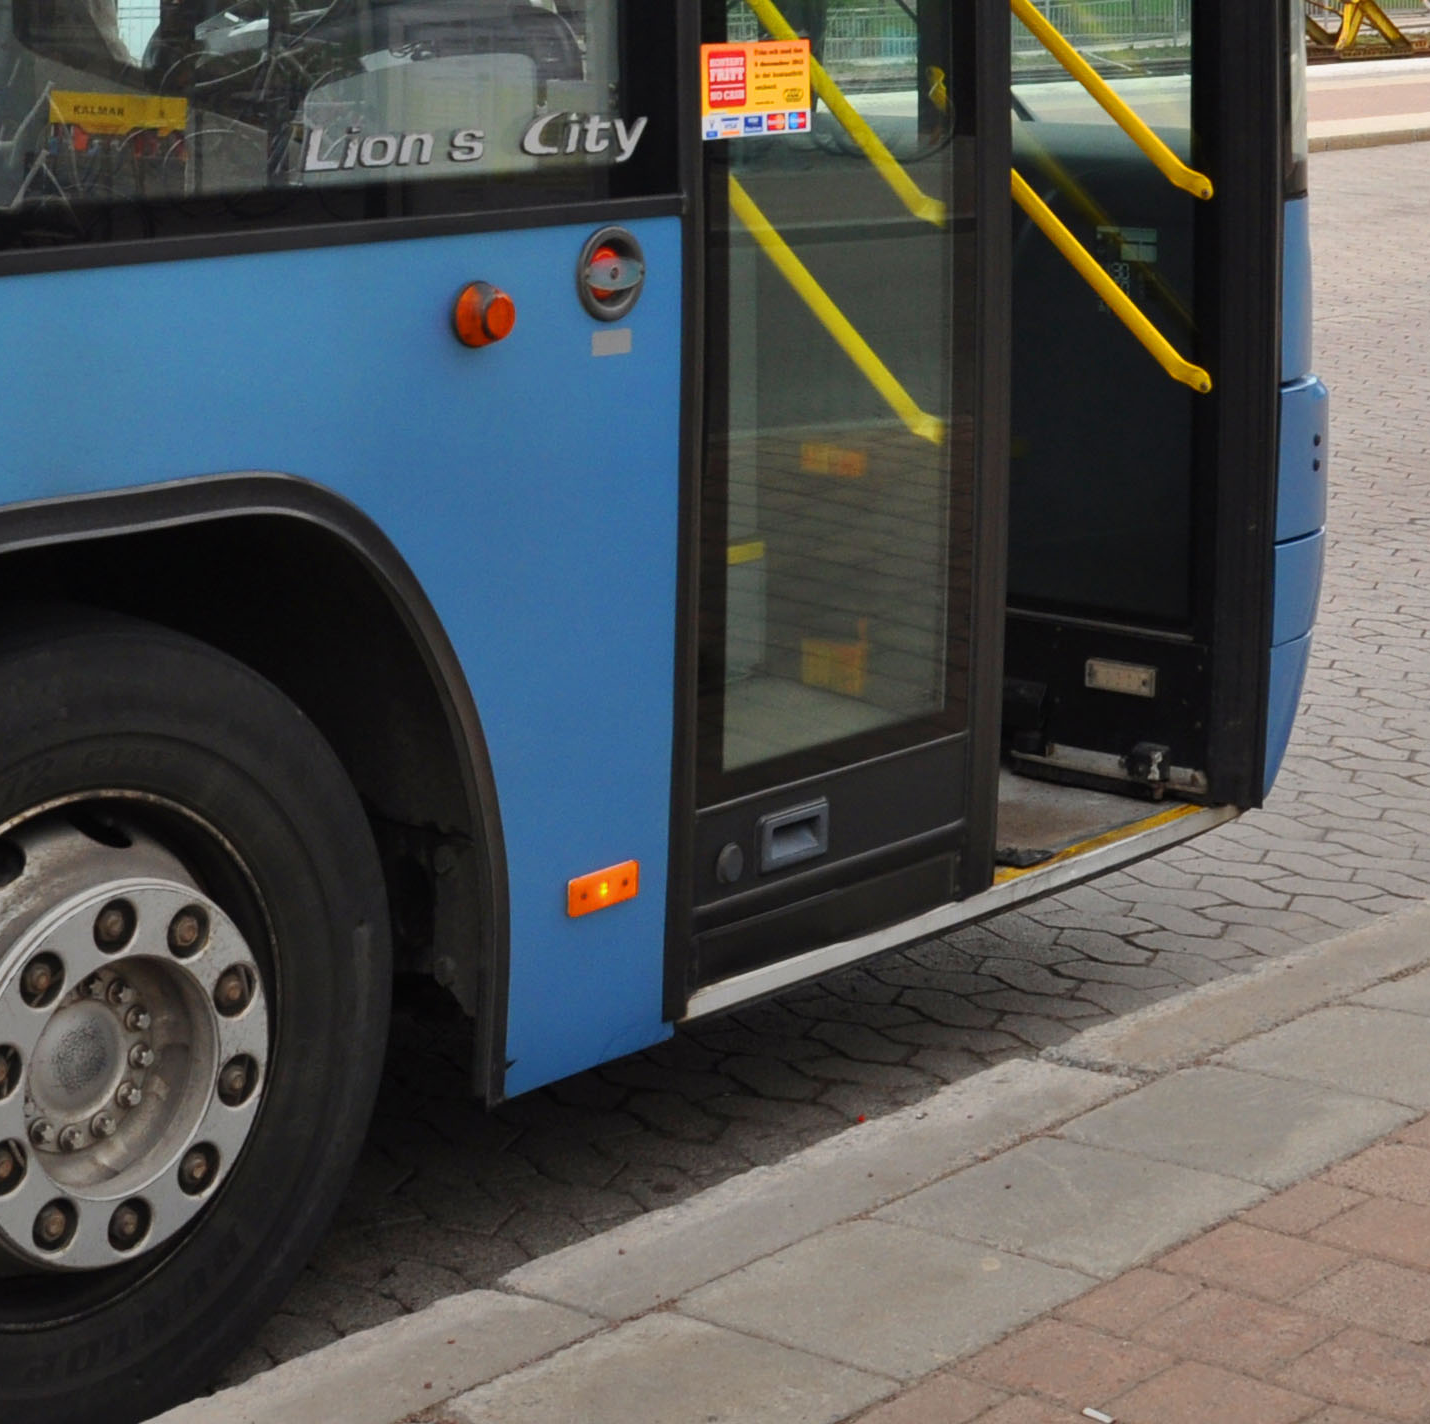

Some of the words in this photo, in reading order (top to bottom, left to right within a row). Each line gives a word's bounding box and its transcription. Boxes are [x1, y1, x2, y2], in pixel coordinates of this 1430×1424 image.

[709, 67, 745, 83] FRITT
[709, 91, 723, 102] NO
[724, 89, 745, 101] CASH
[73, 104, 124, 118] KALMAR
[522, 112, 648, 163] City
